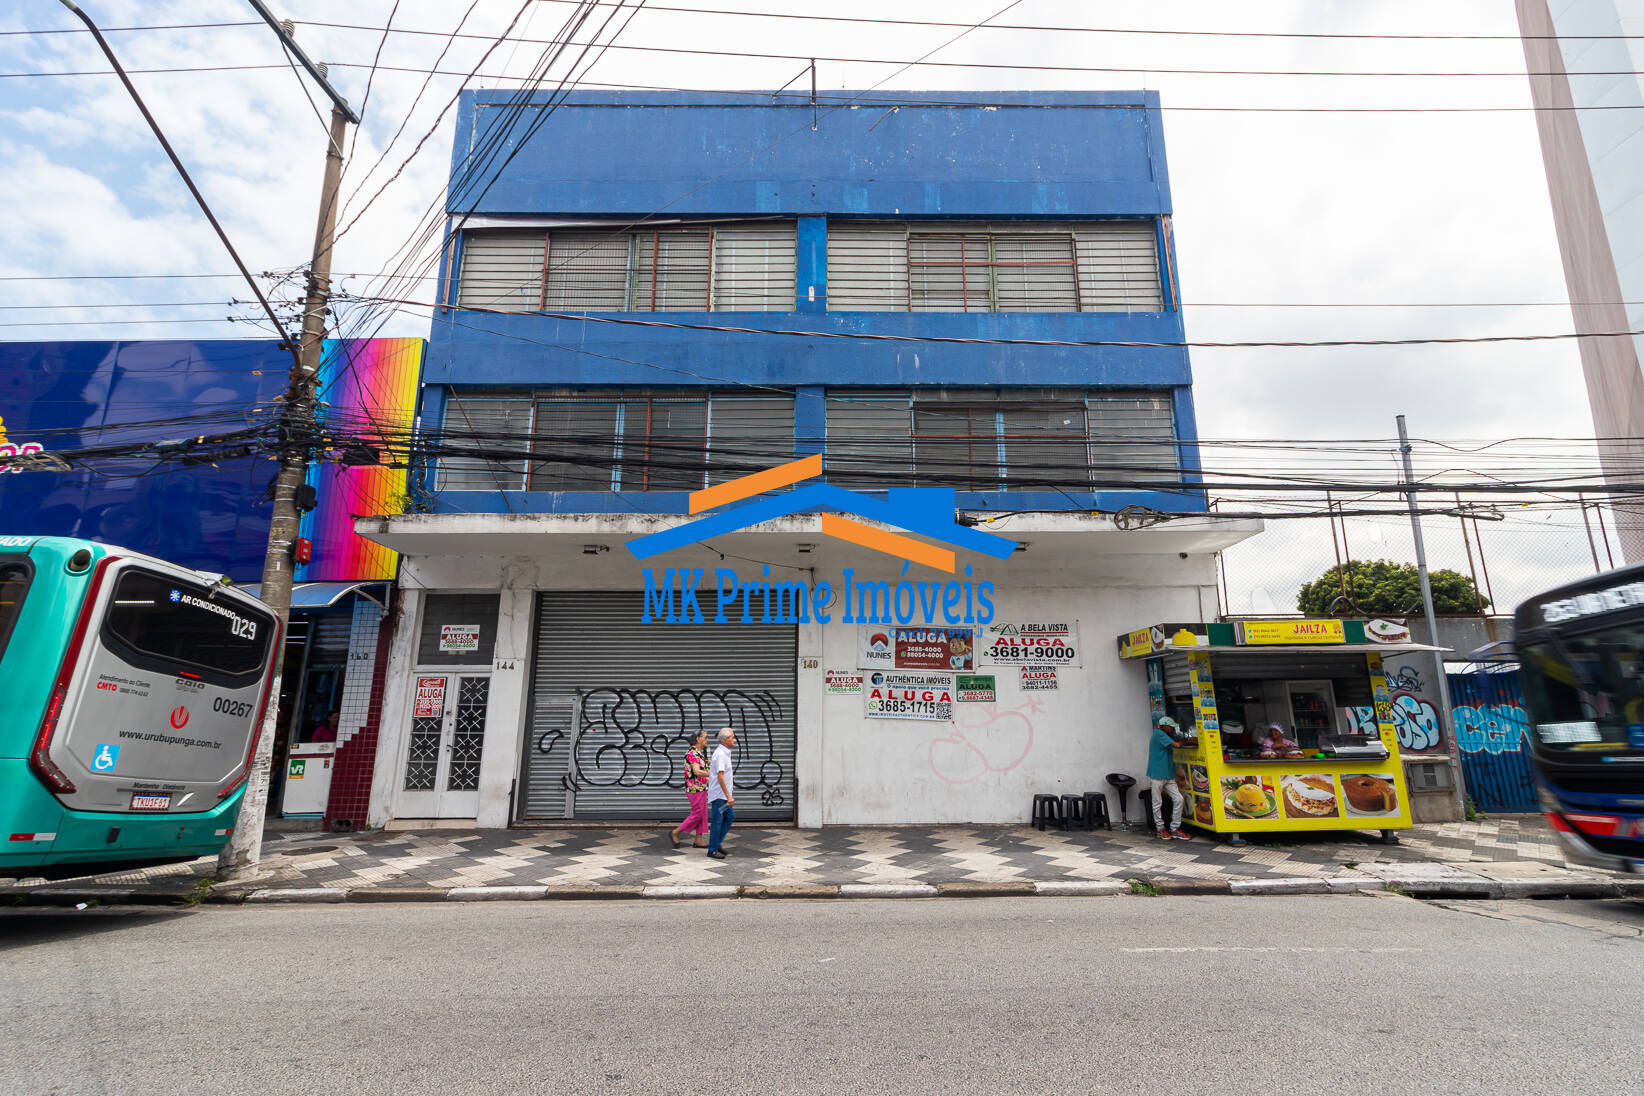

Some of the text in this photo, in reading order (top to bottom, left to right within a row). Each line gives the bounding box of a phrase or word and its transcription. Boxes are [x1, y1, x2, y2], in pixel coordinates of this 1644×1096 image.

[0, 537, 33, 546] ADO
[181, 594, 236, 619] AR CONDICIONADO
[231, 615, 257, 641] 029
[1027, 624, 1047, 632] BELA
[1048, 624, 1069, 632] VISTA
[1293, 623, 1327, 635] JAILZA
[897, 631, 948, 644] ALUGA
[995, 637, 1065, 647] ALUGA
[866, 651, 892, 660] NUNES
[990, 646, 1075, 659] 3681-9000
[496, 661, 515, 670] 144
[803, 660, 819, 669] 140
[885, 674, 925, 684] AUTHÊNTICA
[926, 675, 952, 685] IMÓVEIS
[96, 681, 118, 692] CMTO
[418, 688, 443, 698] ALUGA
[213, 696, 253, 718] 00267
[878, 700, 936, 714] 3685-1715
[119, 730, 222, 750] www.urubupunga.com.br
